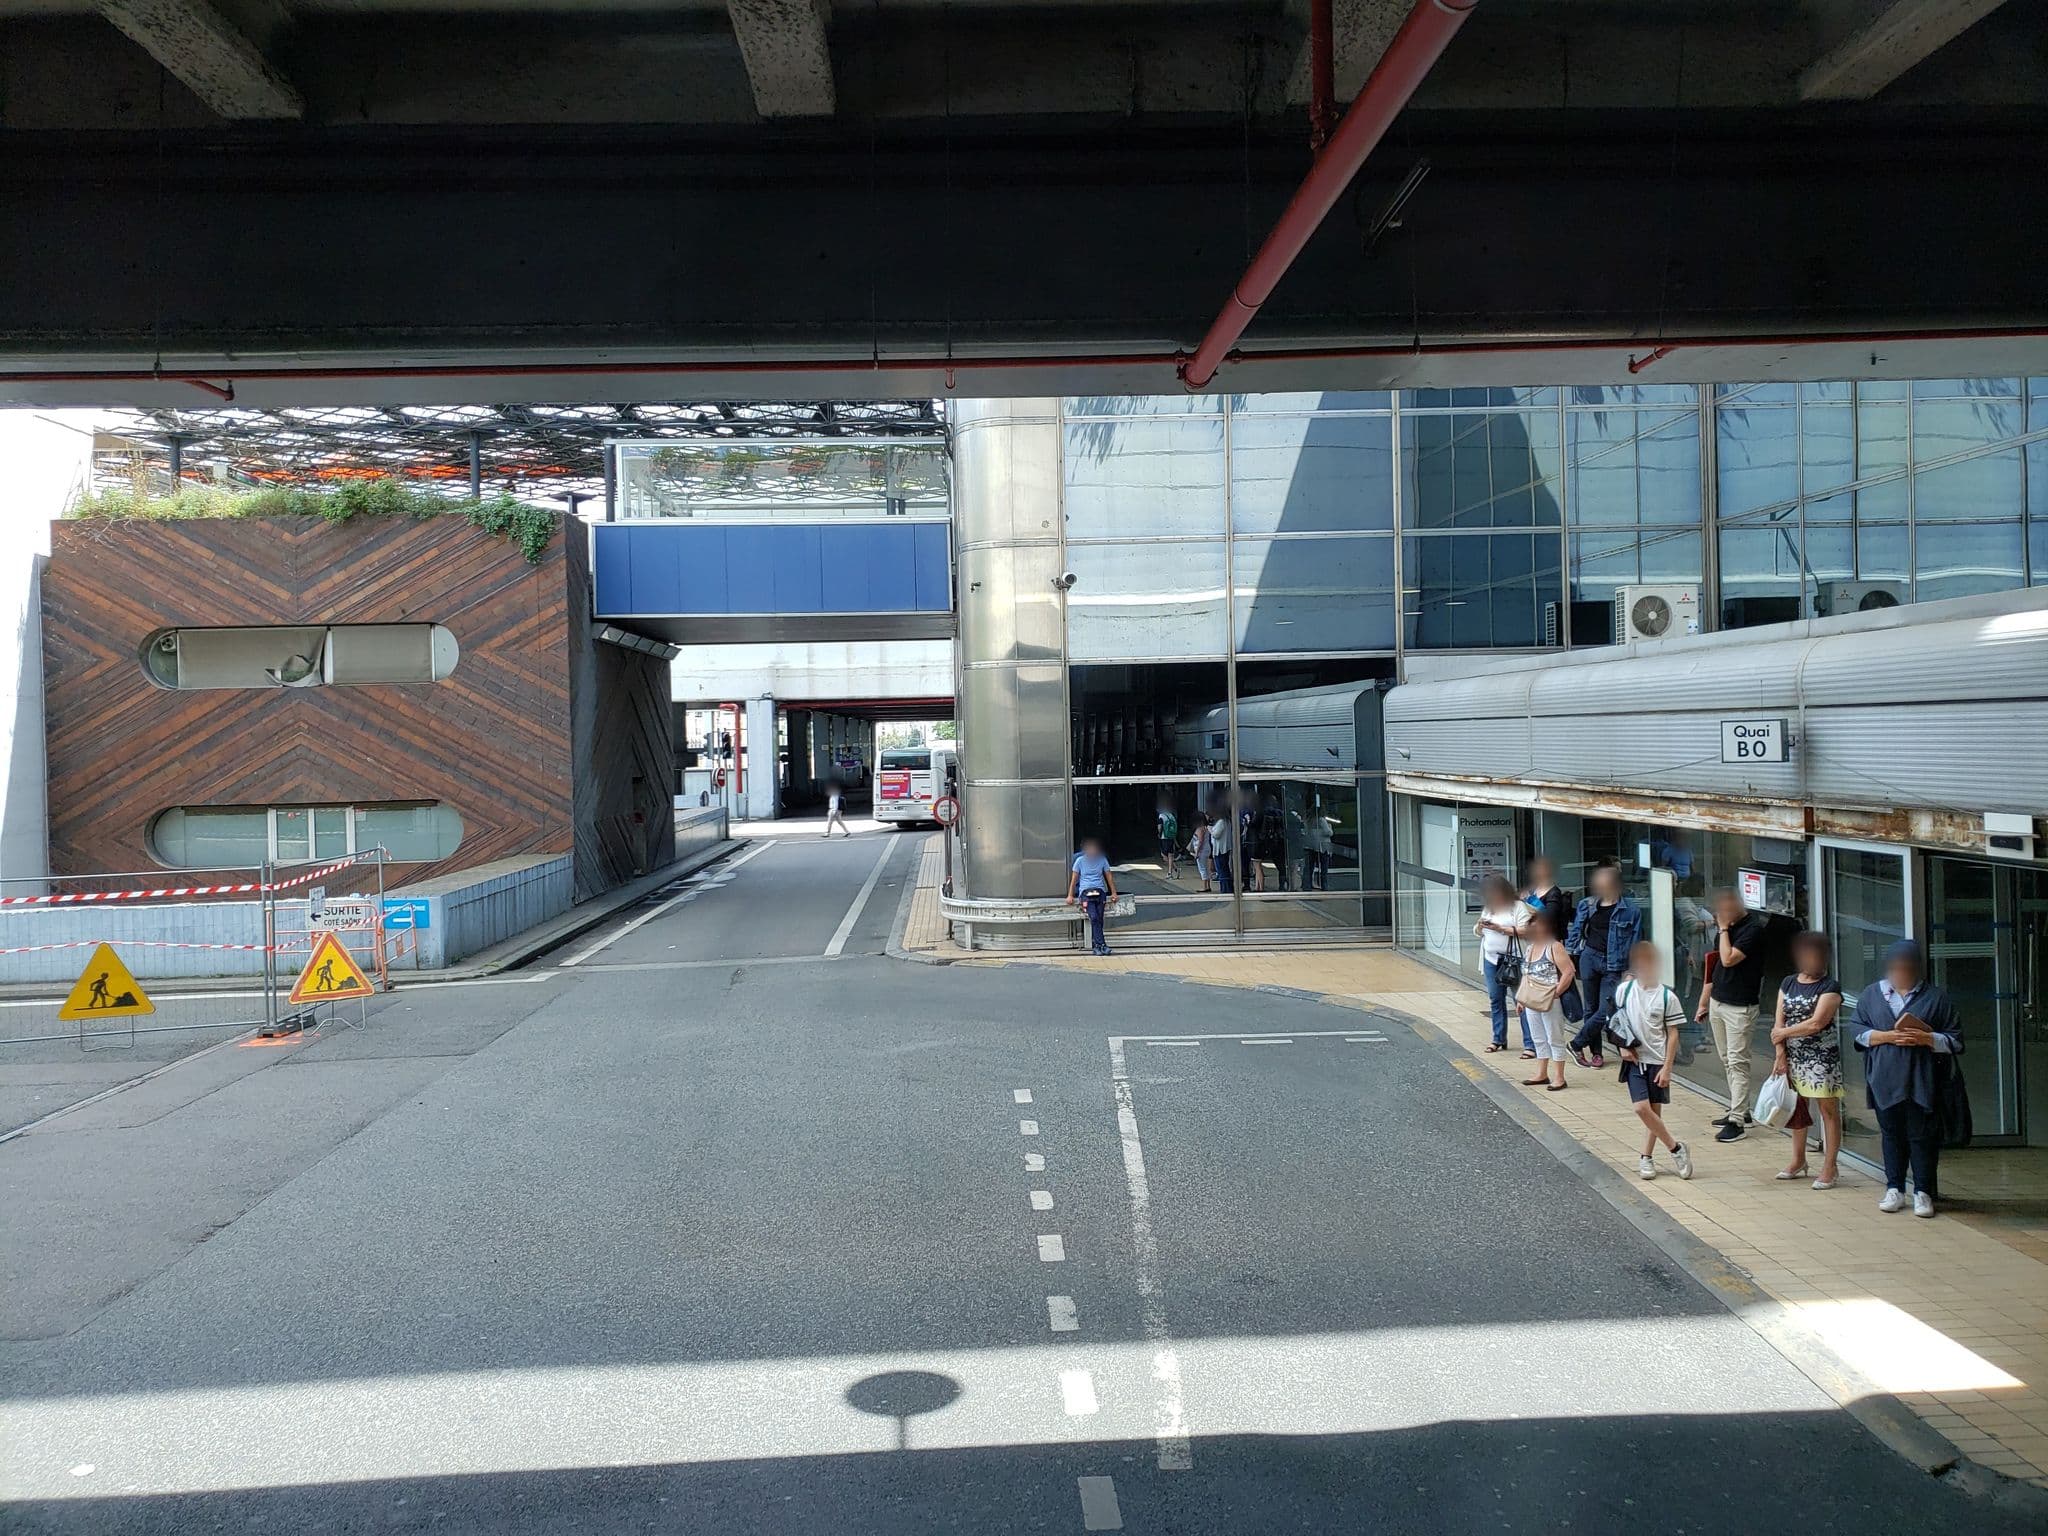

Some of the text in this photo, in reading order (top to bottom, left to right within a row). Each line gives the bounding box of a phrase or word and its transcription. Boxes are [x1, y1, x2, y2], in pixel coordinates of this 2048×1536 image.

[1734, 724, 1770, 738] Quai
[1460, 817, 1511, 827] Photomaton
[324, 906, 361, 916] SORTIE
